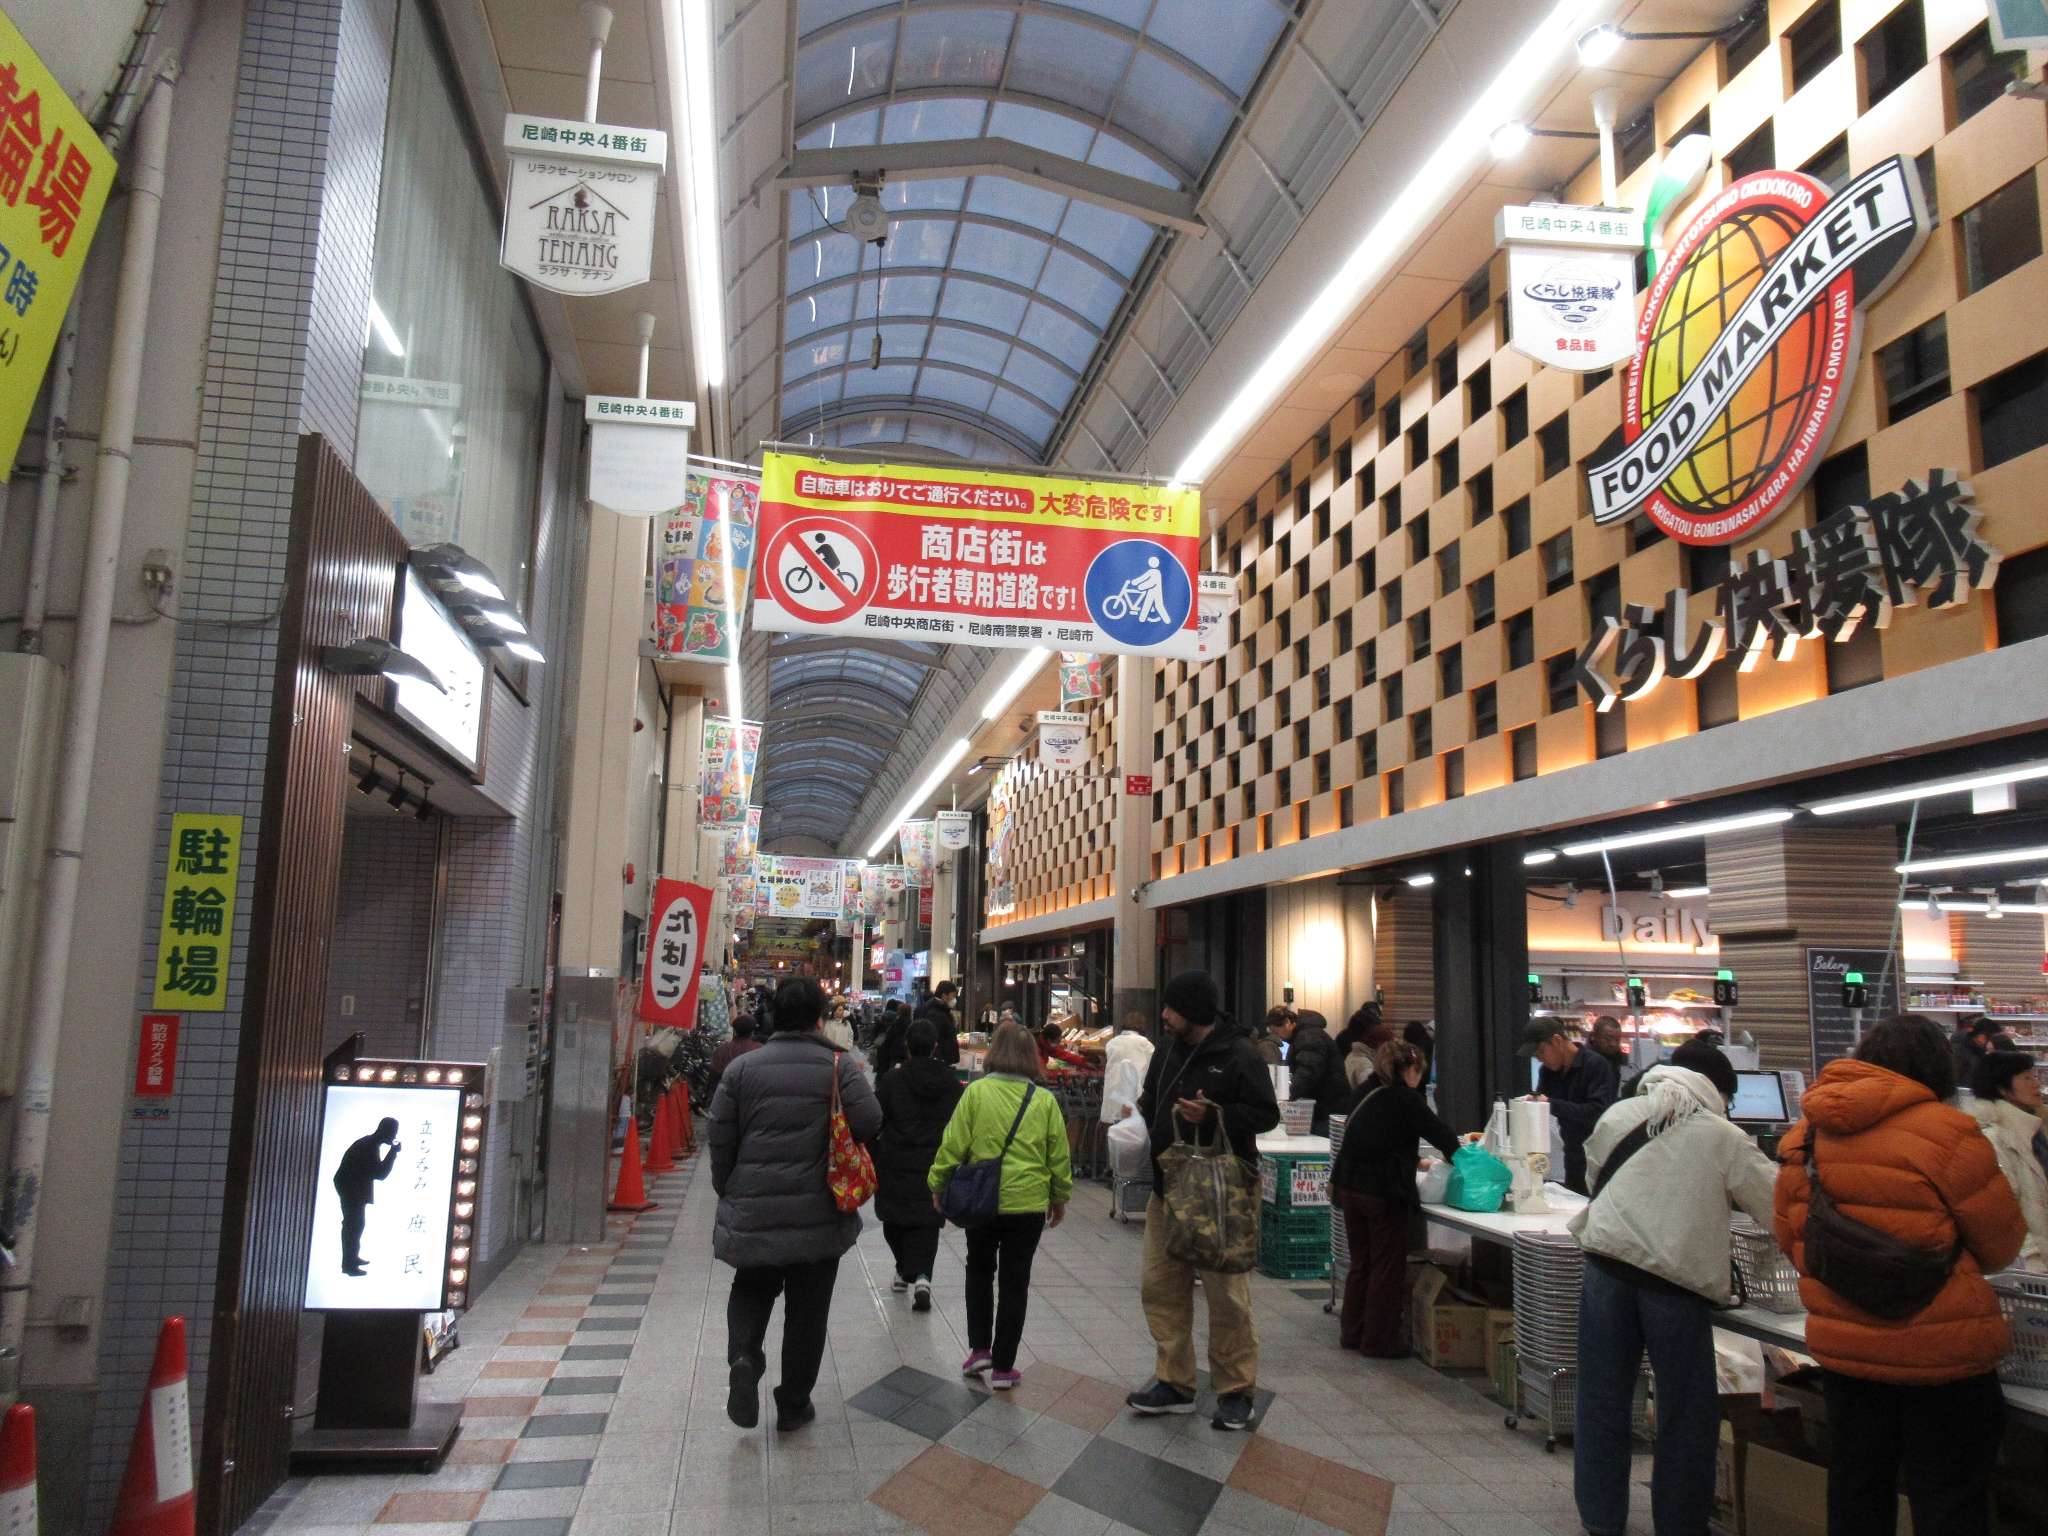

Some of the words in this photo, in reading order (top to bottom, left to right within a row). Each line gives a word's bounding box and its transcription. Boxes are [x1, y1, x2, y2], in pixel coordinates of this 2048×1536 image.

[522, 124, 648, 153] 尼崎中央4番街
[527, 162, 638, 184] リラクゼーションサロン
[1741, 178, 1812, 208] OKIDOKORO
[546, 205, 617, 236] RAKSA
[1521, 216, 1629, 236] 尼崎中央4番街
[538, 238, 619, 269] TENANG
[1531, 284, 1616, 301] くらし快援隊
[1556, 338, 1597, 352] 食品館
[1603, 403, 1697, 508] FOOD
[1702, 183, 1885, 406] MARKET
[597, 402, 684, 419] 尼崎中央4番街
[1651, 500, 1692, 536] ARIGATOU
[1693, 505, 1761, 537] GOMENNASAI
[1759, 472, 1790, 508] KARA
[1787, 386, 1832, 472] HAJIMARU
[1826, 290, 1848, 379] OMOIYARI
[801, 475, 1028, 509] 自転車はおりてご通行ください。
[921, 525, 1047, 566] 商店街は
[888, 564, 1076, 610] 歩行者専用道路です!
[1576, 468, 1999, 712] くらし快援隊
[163, 828, 231, 996] 駐輪場
[1601, 905, 1709, 948] Daily
[1846, 987, 1856, 1004] 7
